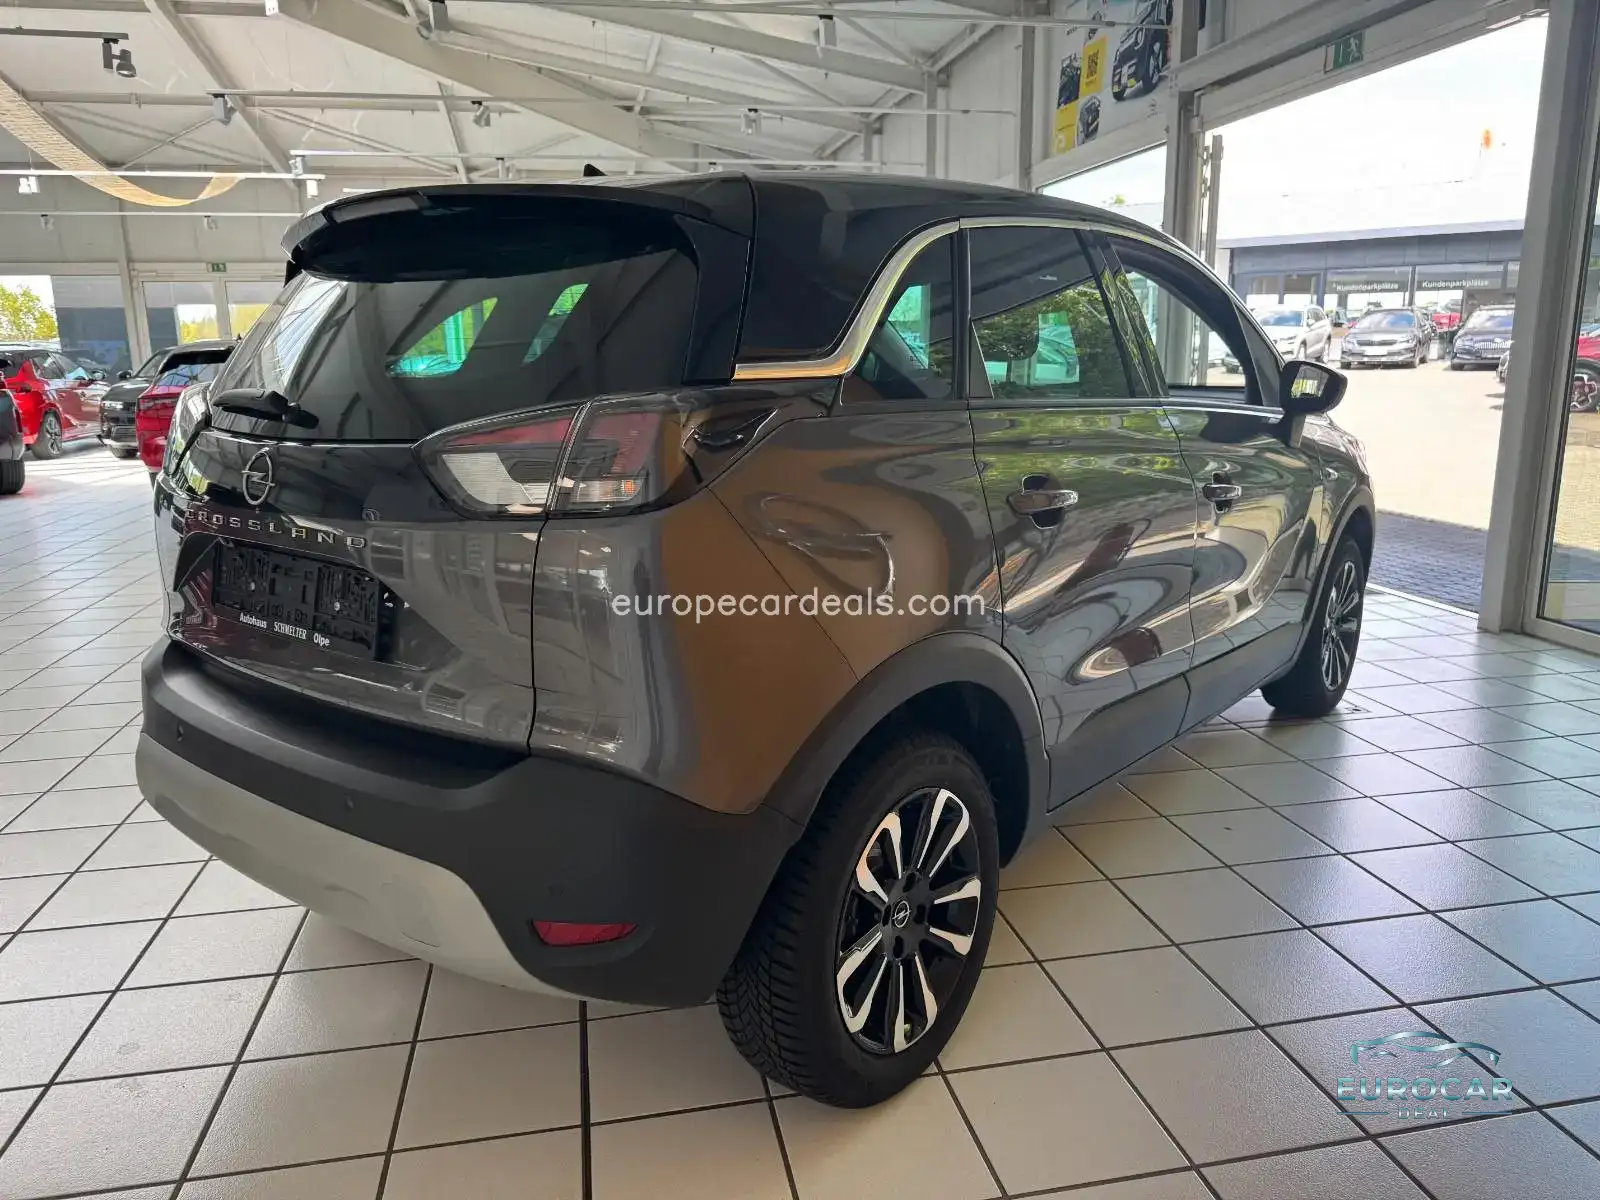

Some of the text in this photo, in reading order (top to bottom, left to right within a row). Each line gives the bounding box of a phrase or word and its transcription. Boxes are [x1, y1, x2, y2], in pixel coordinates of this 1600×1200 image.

[1422, 280, 1489, 289] Kundenparkplätze
[187, 508, 366, 549] CROSSLAND
[240, 612, 330, 647] Autohaus SCHMELTER Olpe
